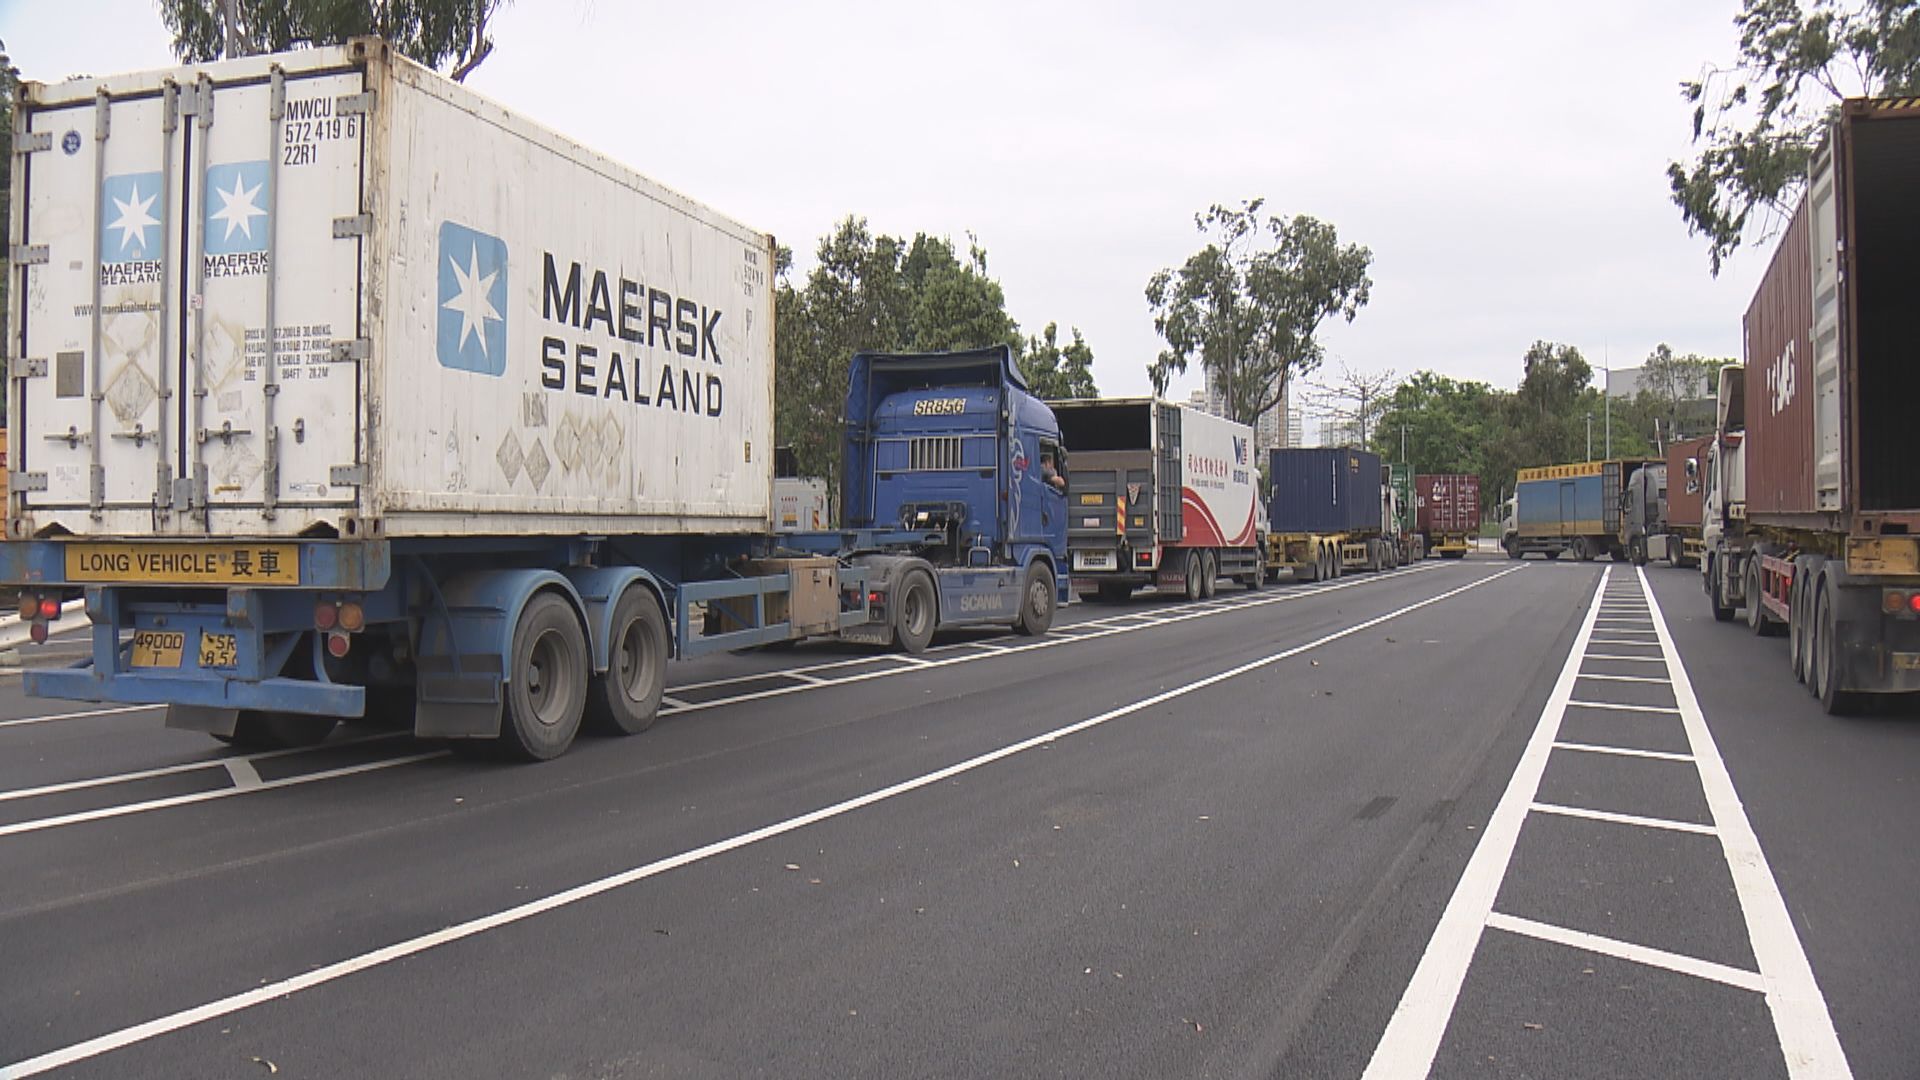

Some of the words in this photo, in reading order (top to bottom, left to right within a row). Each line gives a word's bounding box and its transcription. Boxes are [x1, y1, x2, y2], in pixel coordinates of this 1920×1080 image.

[286, 97, 331, 121] MWCU
[285, 122, 311, 143] 572
[315, 118, 341, 140] 419
[347, 117, 355, 138] 6
[284, 143, 316, 165] 22R1
[102, 261, 161, 276] MAERSK
[204, 252, 268, 268] MAERSK
[542, 251, 722, 366] MAERSK
[541, 335, 723, 418] SEALAND
[915, 399, 963, 415] SR856
[80, 553, 130, 571] LONG
[137, 553, 217, 573] VEHICLE
[231, 549, 281, 577] 長車
[960, 592, 1003, 612] SCANIA
[136, 632, 182, 652] 49000
[152, 650, 162, 666] T
